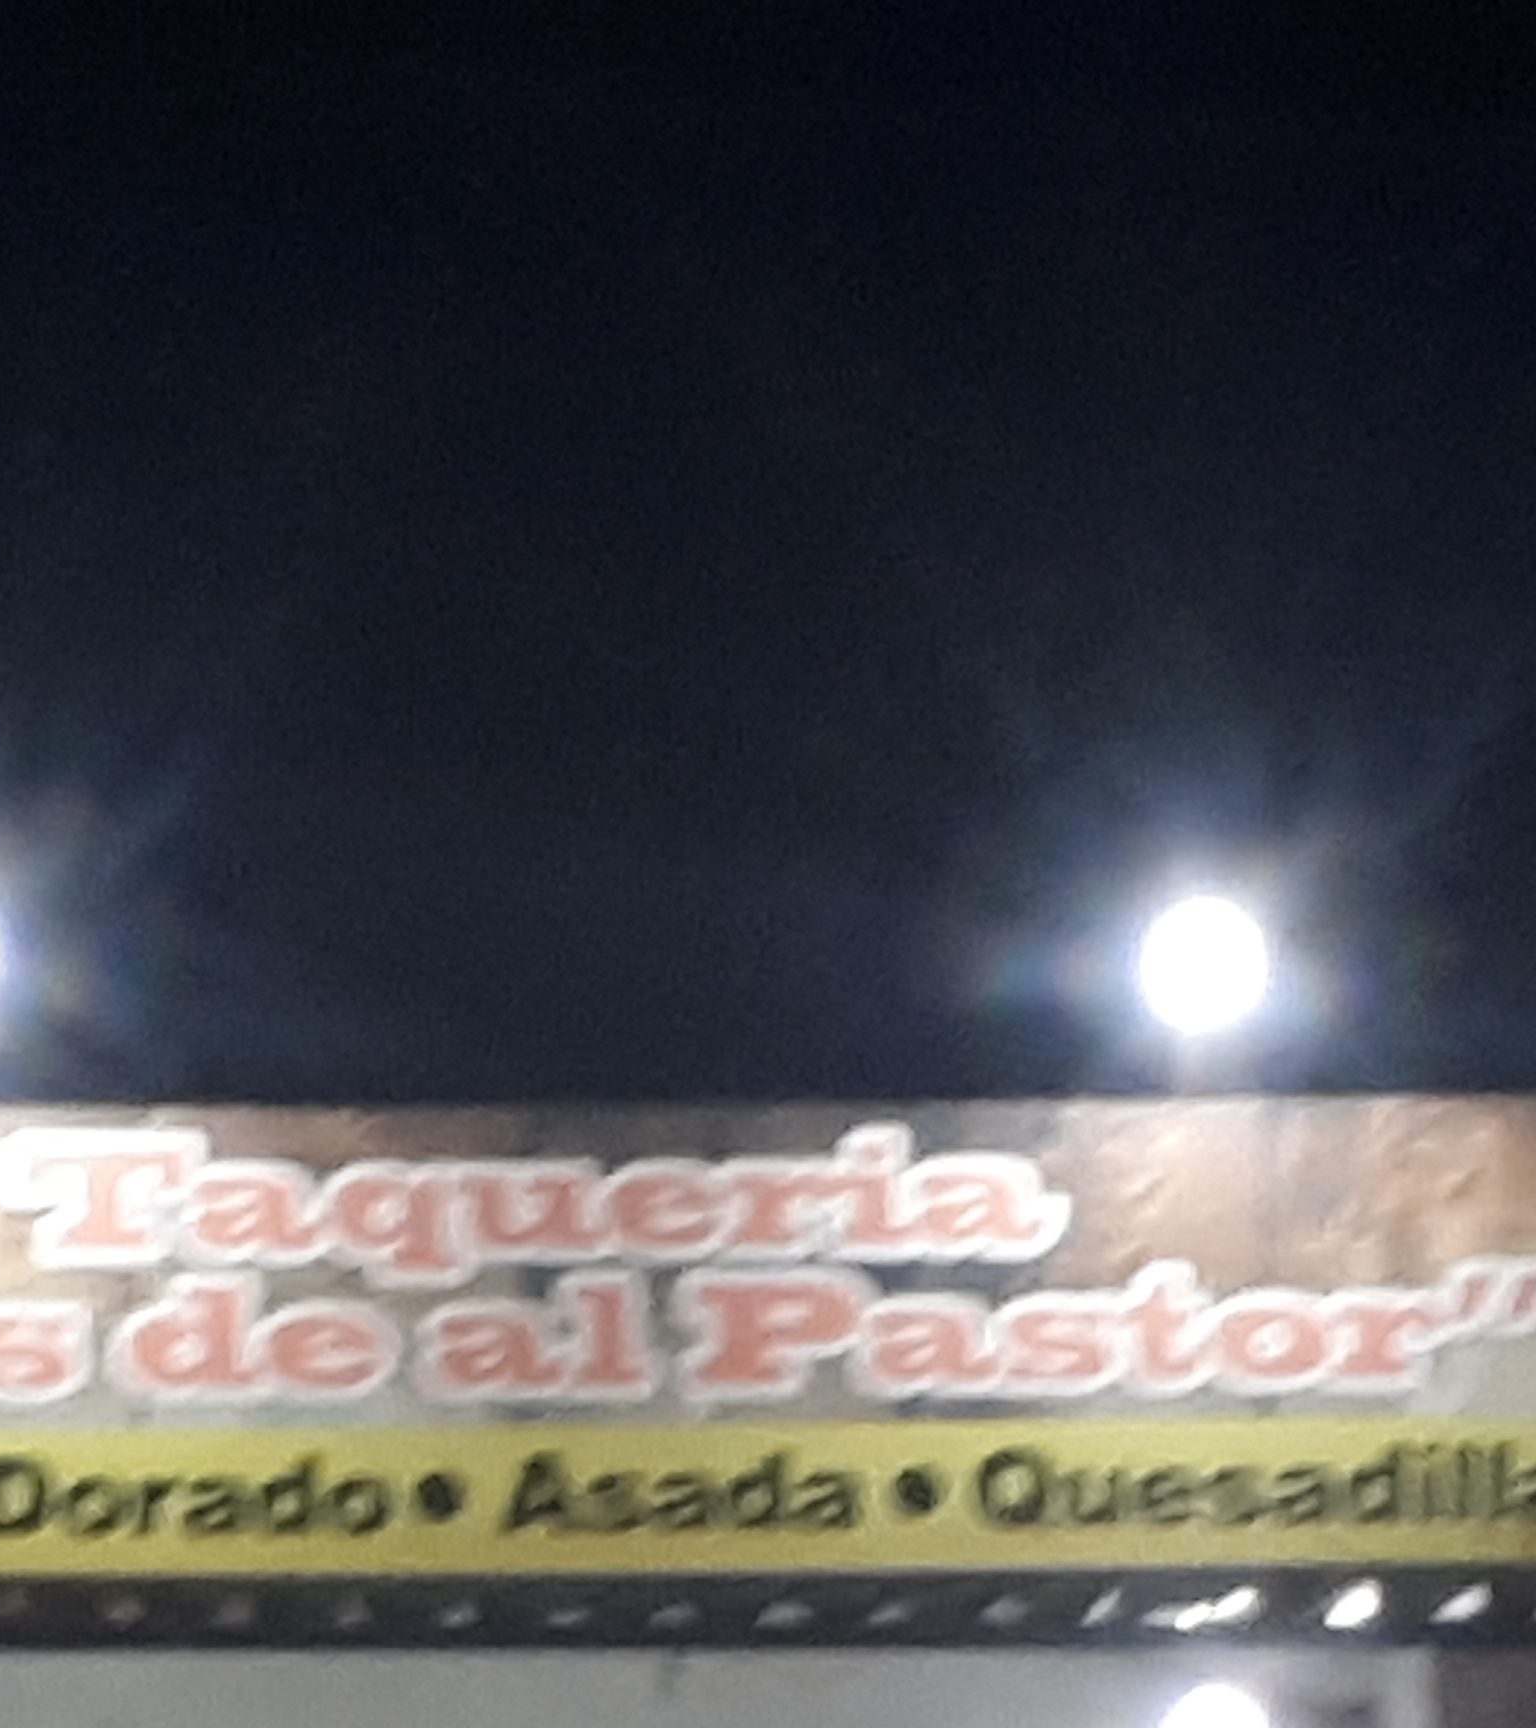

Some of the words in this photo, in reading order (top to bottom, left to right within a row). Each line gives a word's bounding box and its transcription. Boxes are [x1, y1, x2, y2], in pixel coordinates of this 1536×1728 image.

[0, 1130, 1064, 1280] Taqueria
[119, 1278, 392, 1393] de
[426, 1278, 652, 1393] al
[506, 1449, 861, 1532] Asada
